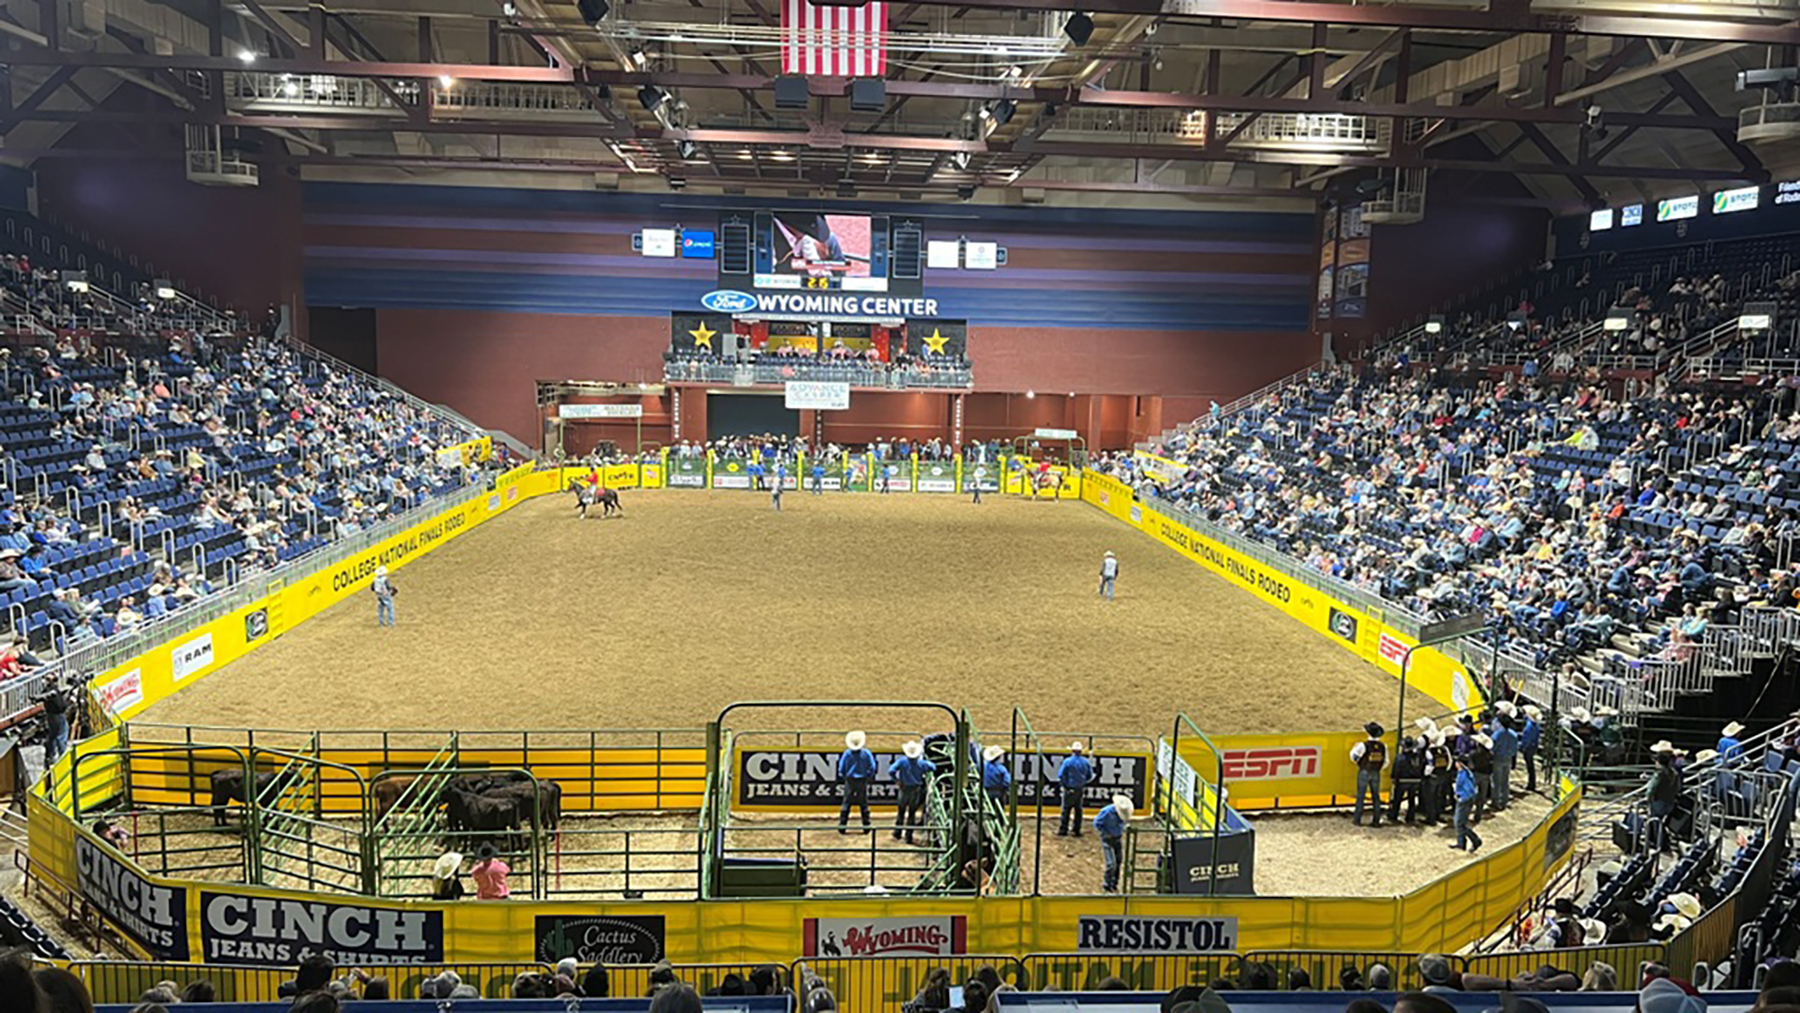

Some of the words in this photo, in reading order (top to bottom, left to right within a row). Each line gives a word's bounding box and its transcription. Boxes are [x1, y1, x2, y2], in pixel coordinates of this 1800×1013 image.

[756, 294, 858, 314] WYOMING
[862, 297, 938, 316] CENTER
[333, 556, 377, 592] COLLEGE
[379, 535, 418, 567] NATIONAL
[419, 522, 444, 546] FINALS
[1160, 522, 1188, 550] COLLEGE
[1190, 535, 1225, 569] NATIONAL
[1226, 557, 1256, 586] FINALS
[1258, 573, 1291, 603] RODEO
[184, 643, 212, 663] RAM
[746, 753, 897, 782] CINH
[1001, 754, 1136, 785] INH
[1222, 748, 1318, 778] ESPN
[747, 783, 811, 798] JEANS
[815, 785, 830, 796] &
[835, 784, 899, 797] SIRT
[1041, 785, 1055, 798] &
[76, 837, 173, 927] CINCH
[119, 906, 173, 947] SHIRTS
[207, 896, 426, 950] CINCH
[583, 925, 637, 947] Cactus
[1078, 918, 1230, 951] RESISTOL
[210, 938, 291, 961] JEANS
[297, 947, 316, 963] &
[577, 945, 643, 964] Saddlery
